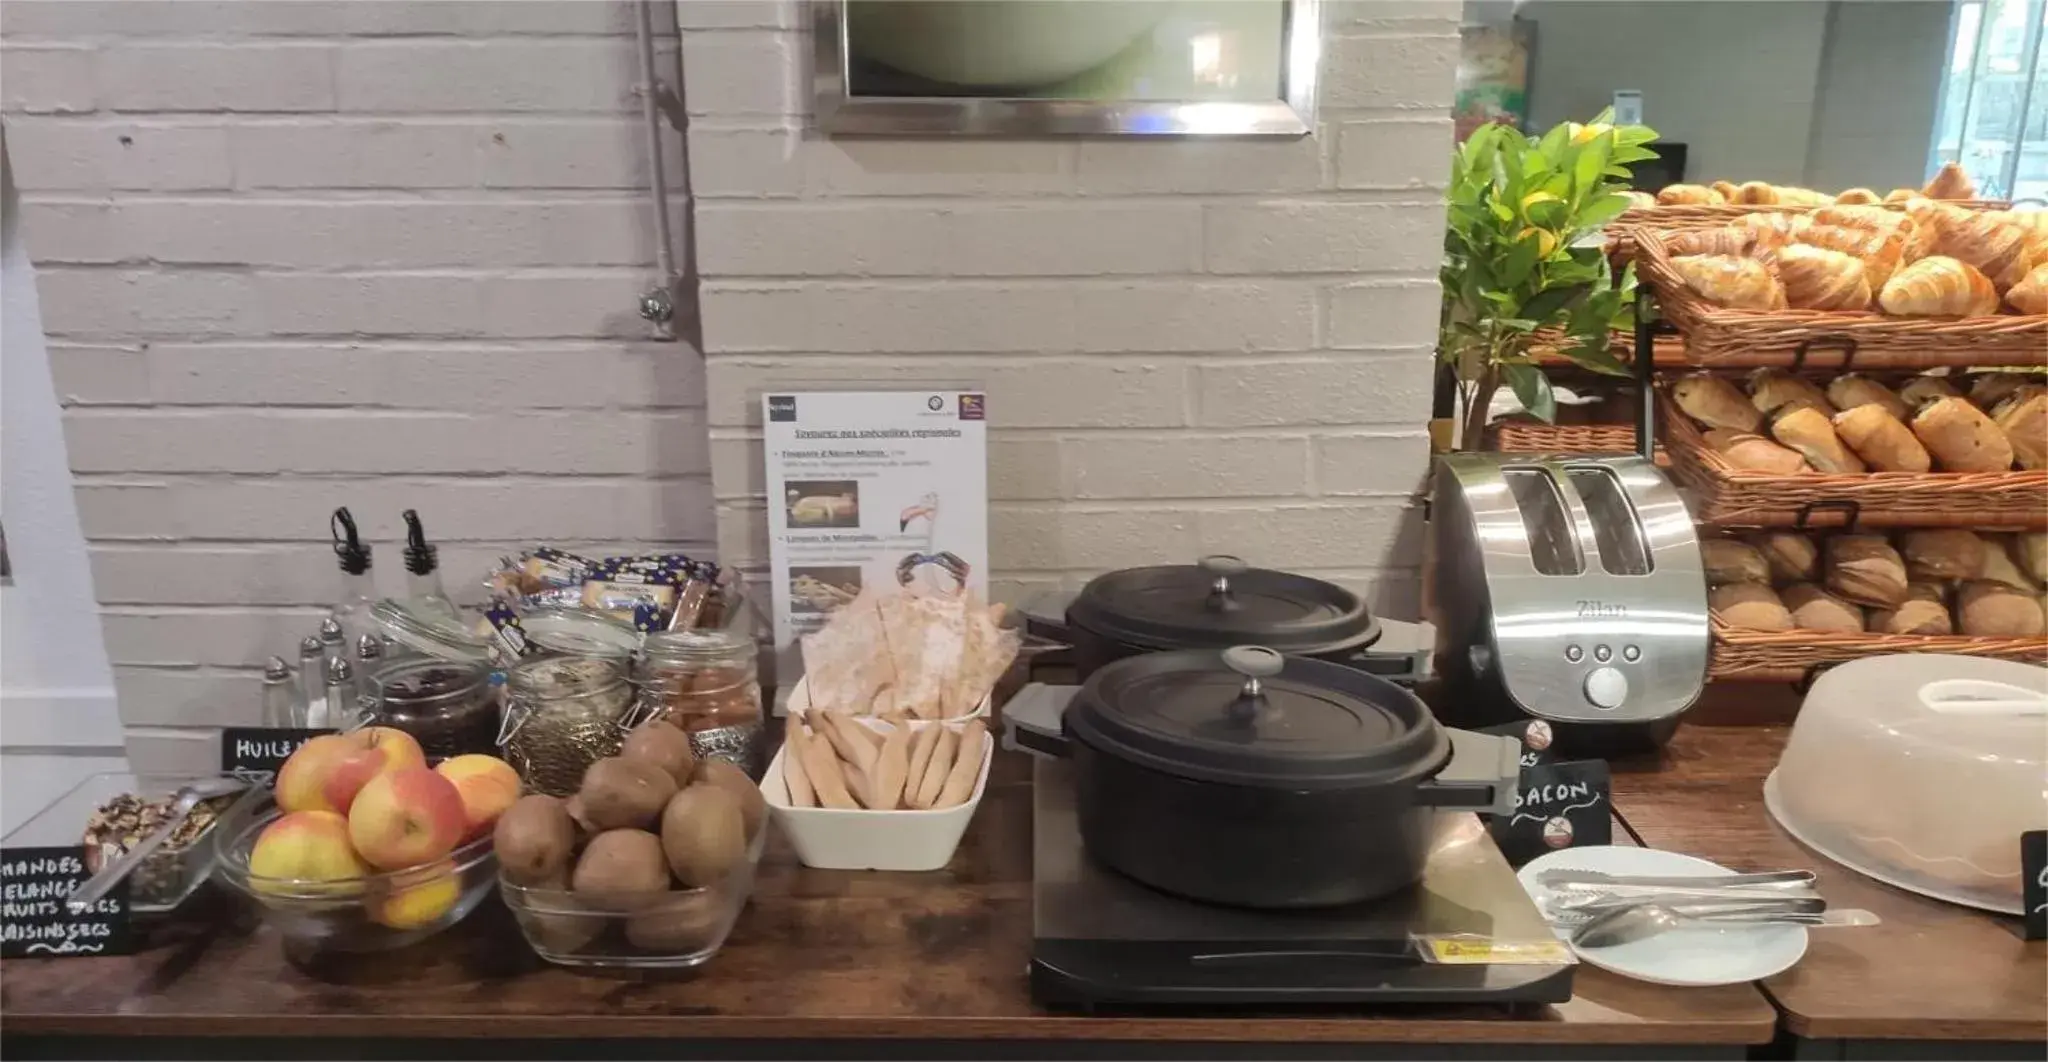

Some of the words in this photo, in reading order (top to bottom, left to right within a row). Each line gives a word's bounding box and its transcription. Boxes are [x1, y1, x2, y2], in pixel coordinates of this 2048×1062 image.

[1576, 600, 1627, 617] Zilan
[236, 739, 292, 758] HUILE
[0, 857, 82, 877] MANDES
[0, 880, 77, 900] ELANGE
[0, 901, 59, 917] RUITS
